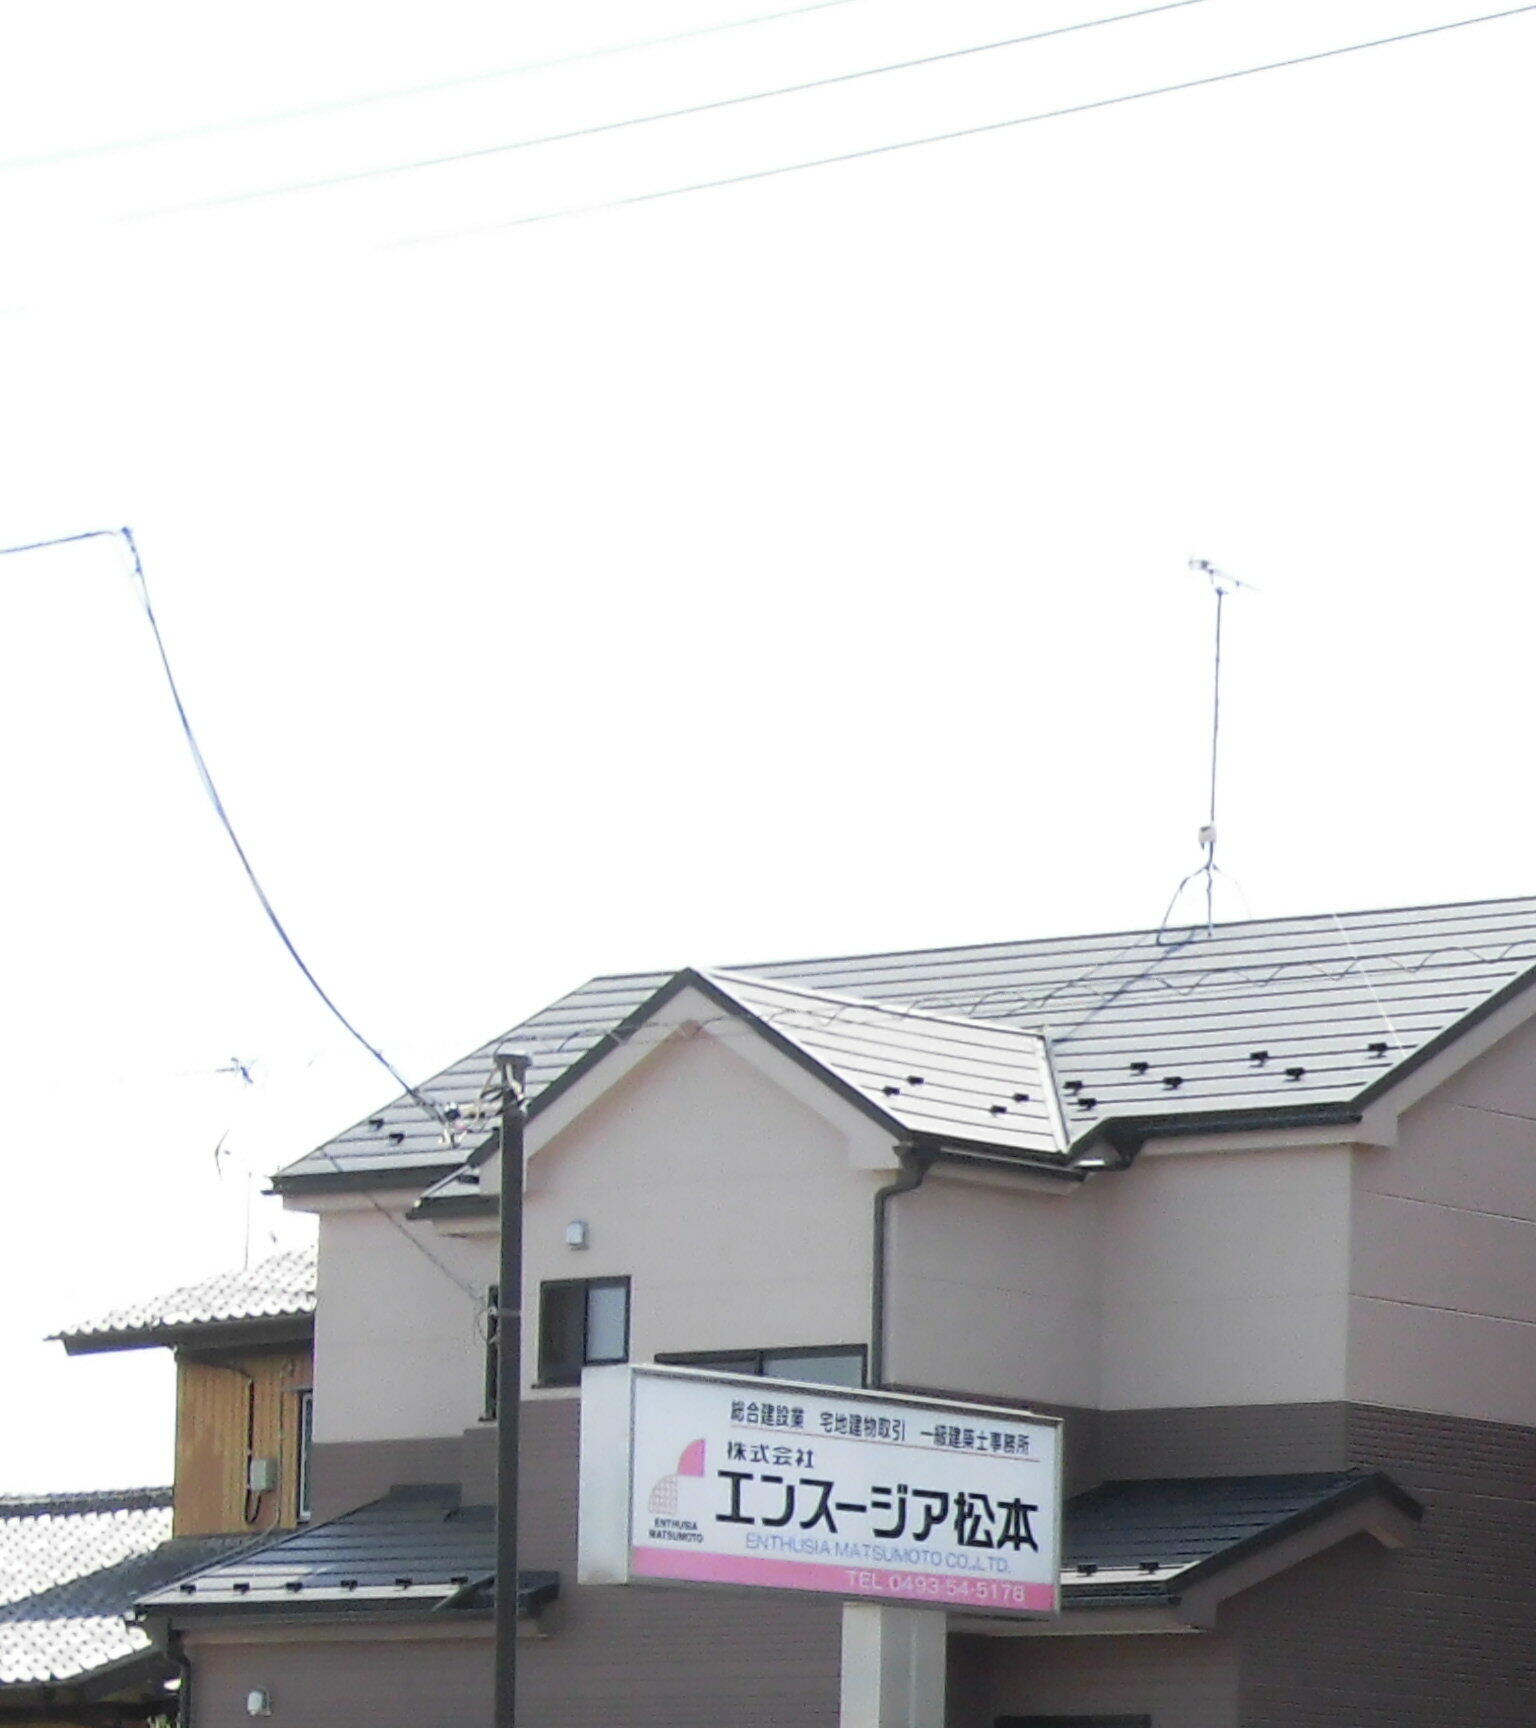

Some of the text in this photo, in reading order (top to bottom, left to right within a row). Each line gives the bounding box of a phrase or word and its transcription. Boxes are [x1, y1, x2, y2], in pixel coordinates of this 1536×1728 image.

[820, 1411, 905, 1441] 宅地建物取引
[920, 1425, 1029, 1455] 一級建築士事務所
[727, 1441, 814, 1468] 株式会社
[654, 1518, 698, 1531] ENTHUSIA
[716, 1470, 1038, 1552] エンスージア松本
[649, 1530, 703, 1543] MATSUMOTO
[746, 1532, 830, 1556] ENTHUSIA
[835, 1542, 942, 1567] MATSUMOTO
[845, 1570, 882, 1590] TEL
